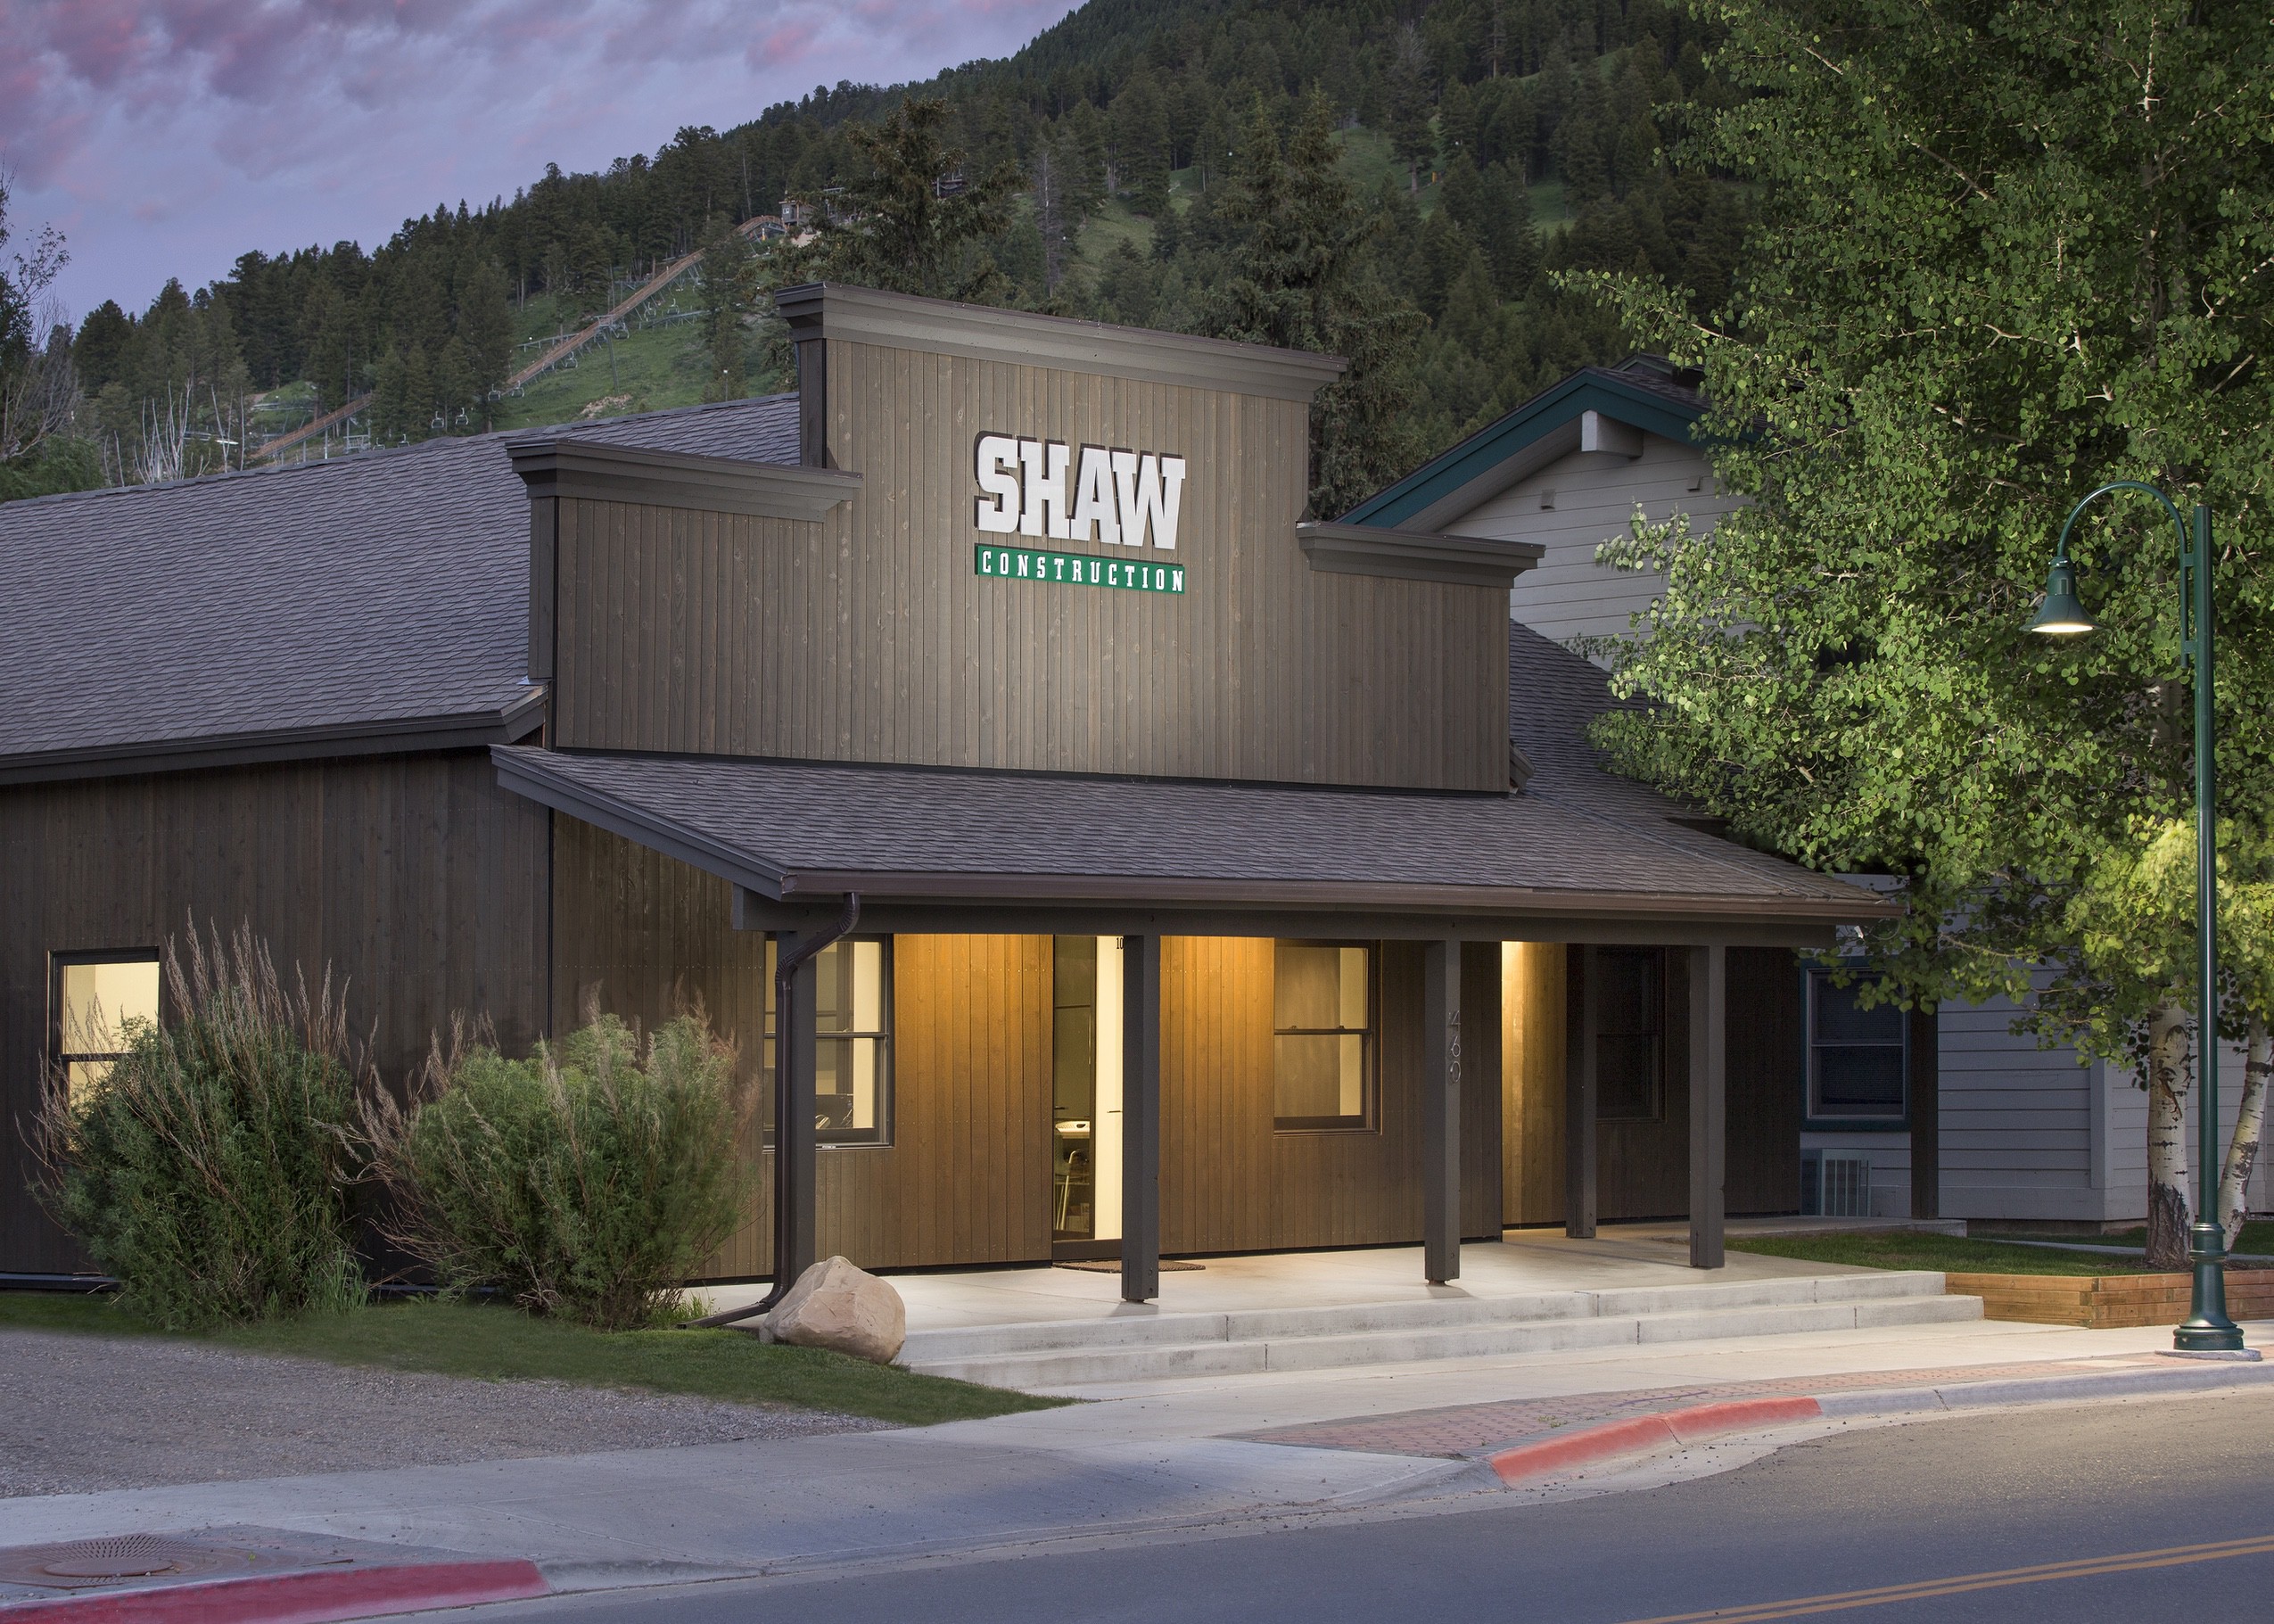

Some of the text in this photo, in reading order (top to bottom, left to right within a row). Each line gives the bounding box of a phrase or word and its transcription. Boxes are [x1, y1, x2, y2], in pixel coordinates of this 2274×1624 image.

[977, 434, 1186, 549] SHAW
[982, 550, 1184, 592] CONSTRUCTION
[1450, 1010, 1462, 1083] 460
